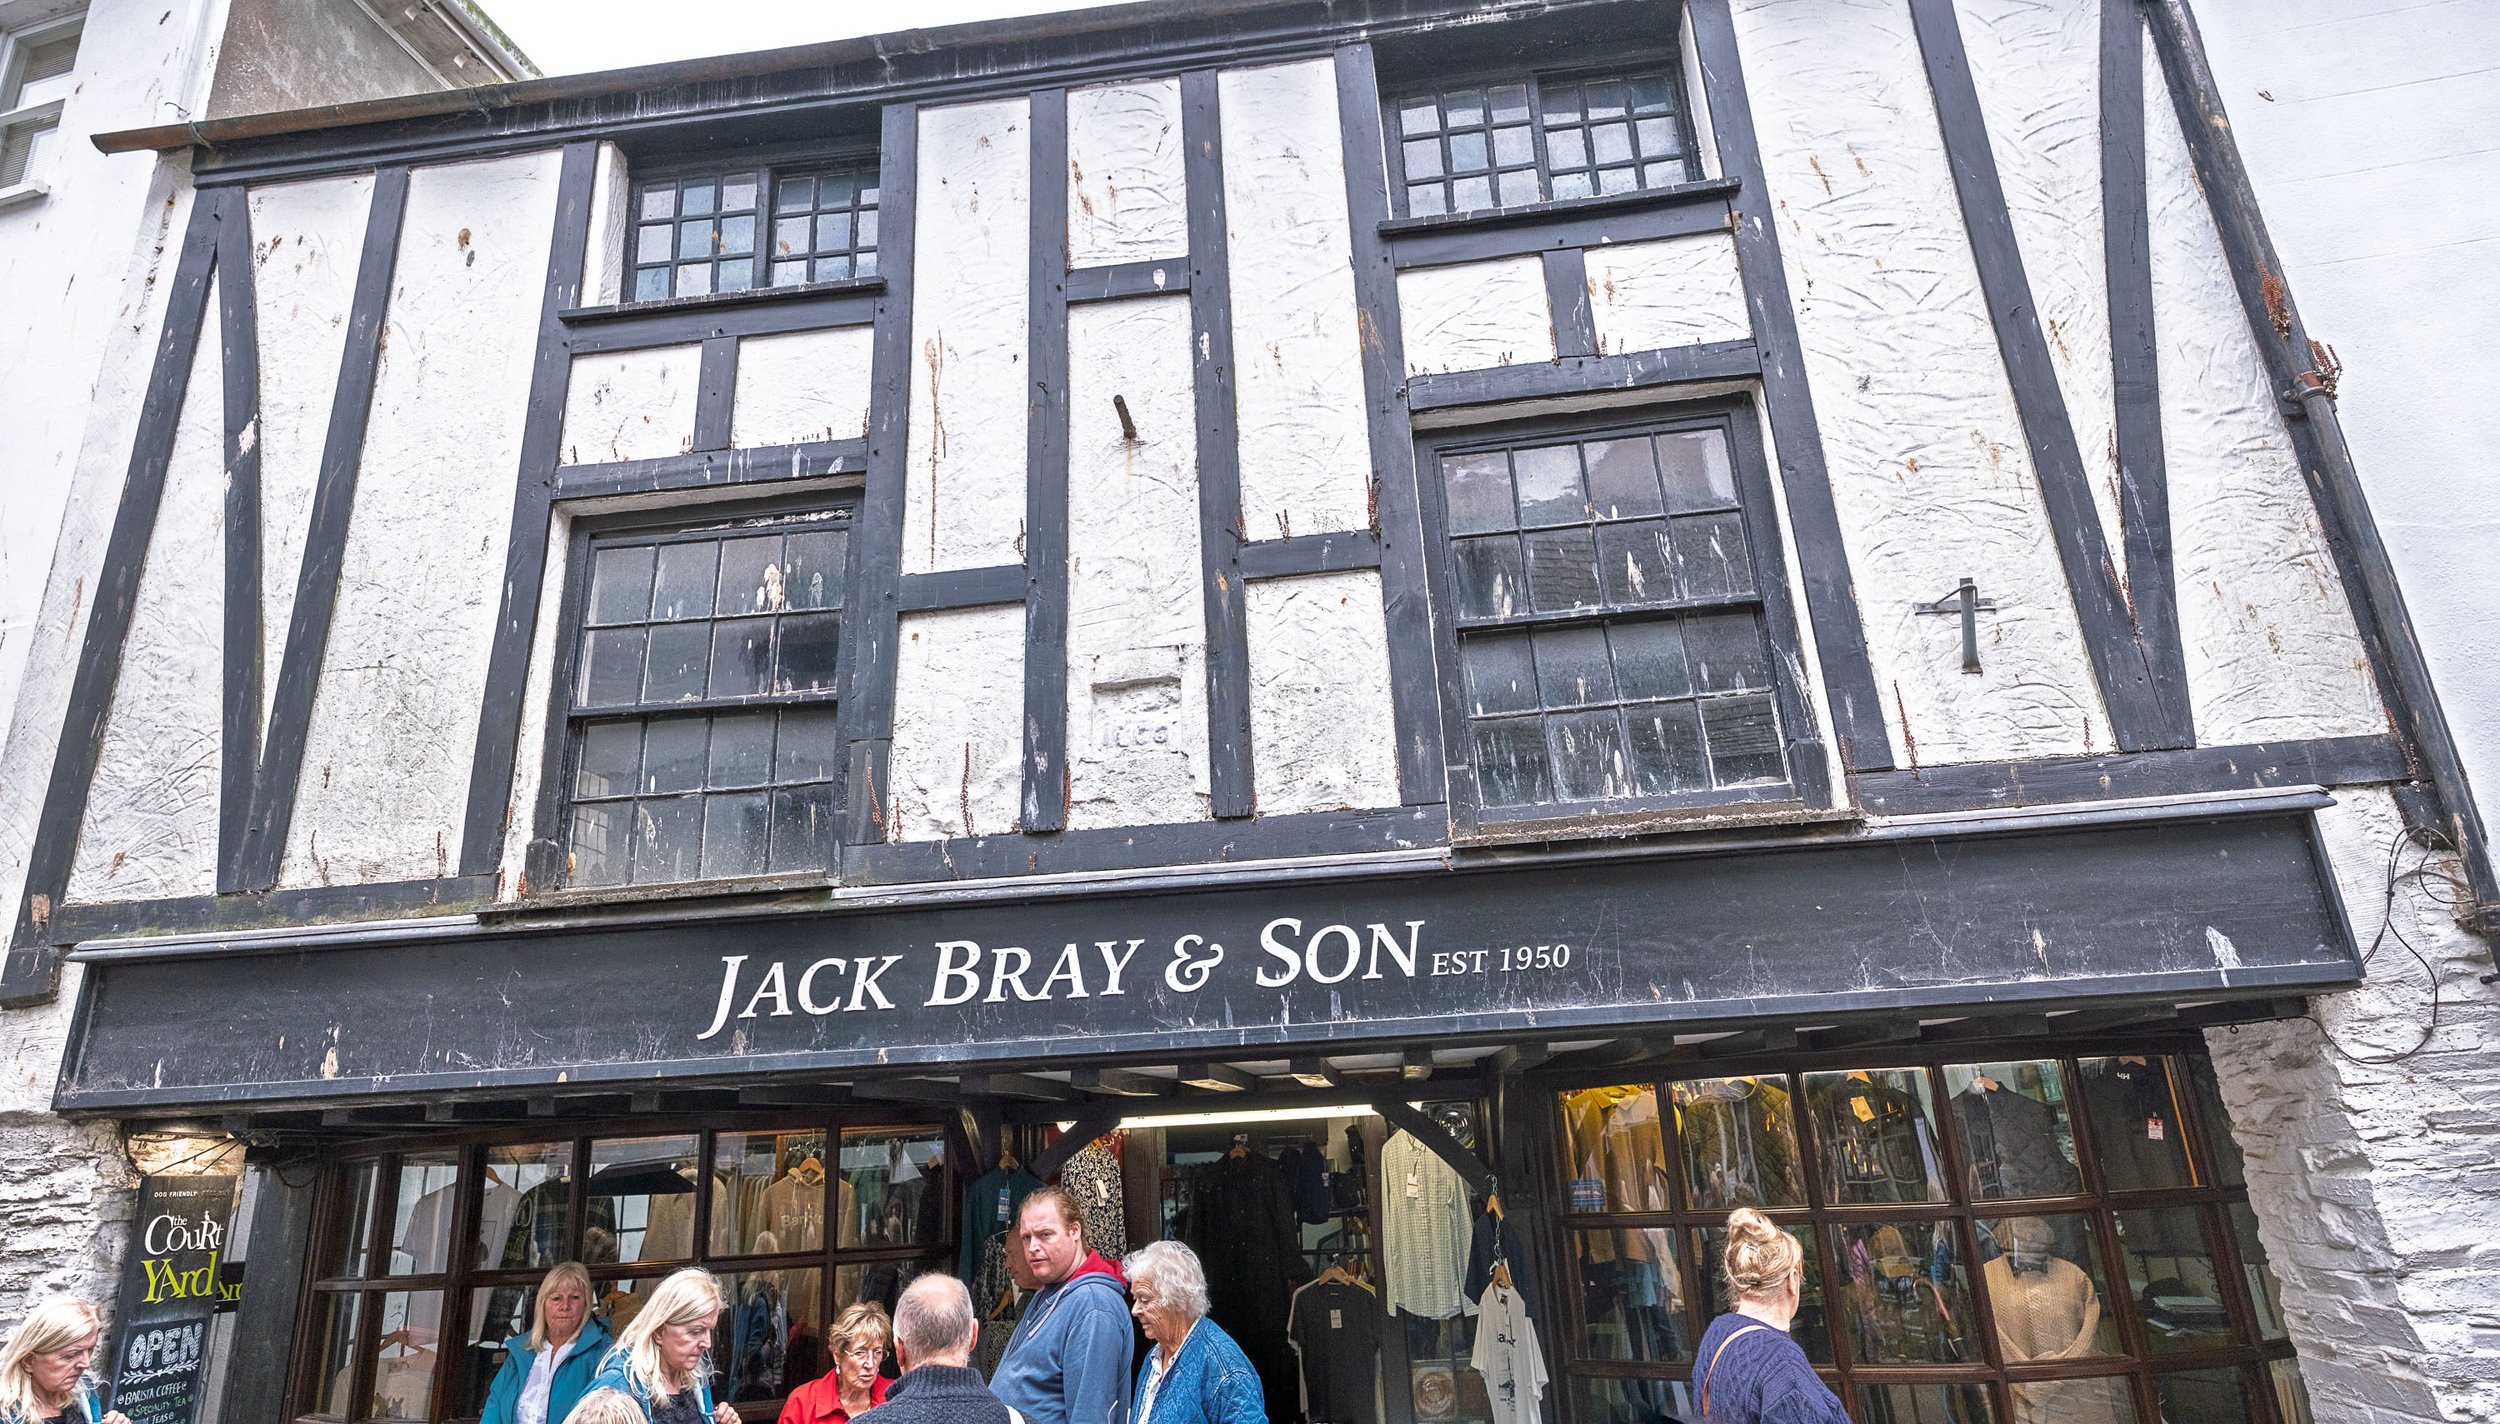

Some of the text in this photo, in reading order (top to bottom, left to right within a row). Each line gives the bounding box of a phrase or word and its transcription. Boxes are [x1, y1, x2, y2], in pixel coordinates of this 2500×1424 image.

[696, 916, 1571, 1041] JACK BRAY & SON EST 1950
[154, 1190, 168, 1198] DOG
[168, 1190, 198, 1198] FRIENDLY
[173, 1215, 188, 1226] the
[128, 1322, 204, 1369] OPEN
[124, 1381, 181, 1406] BARISTA COFFEE
